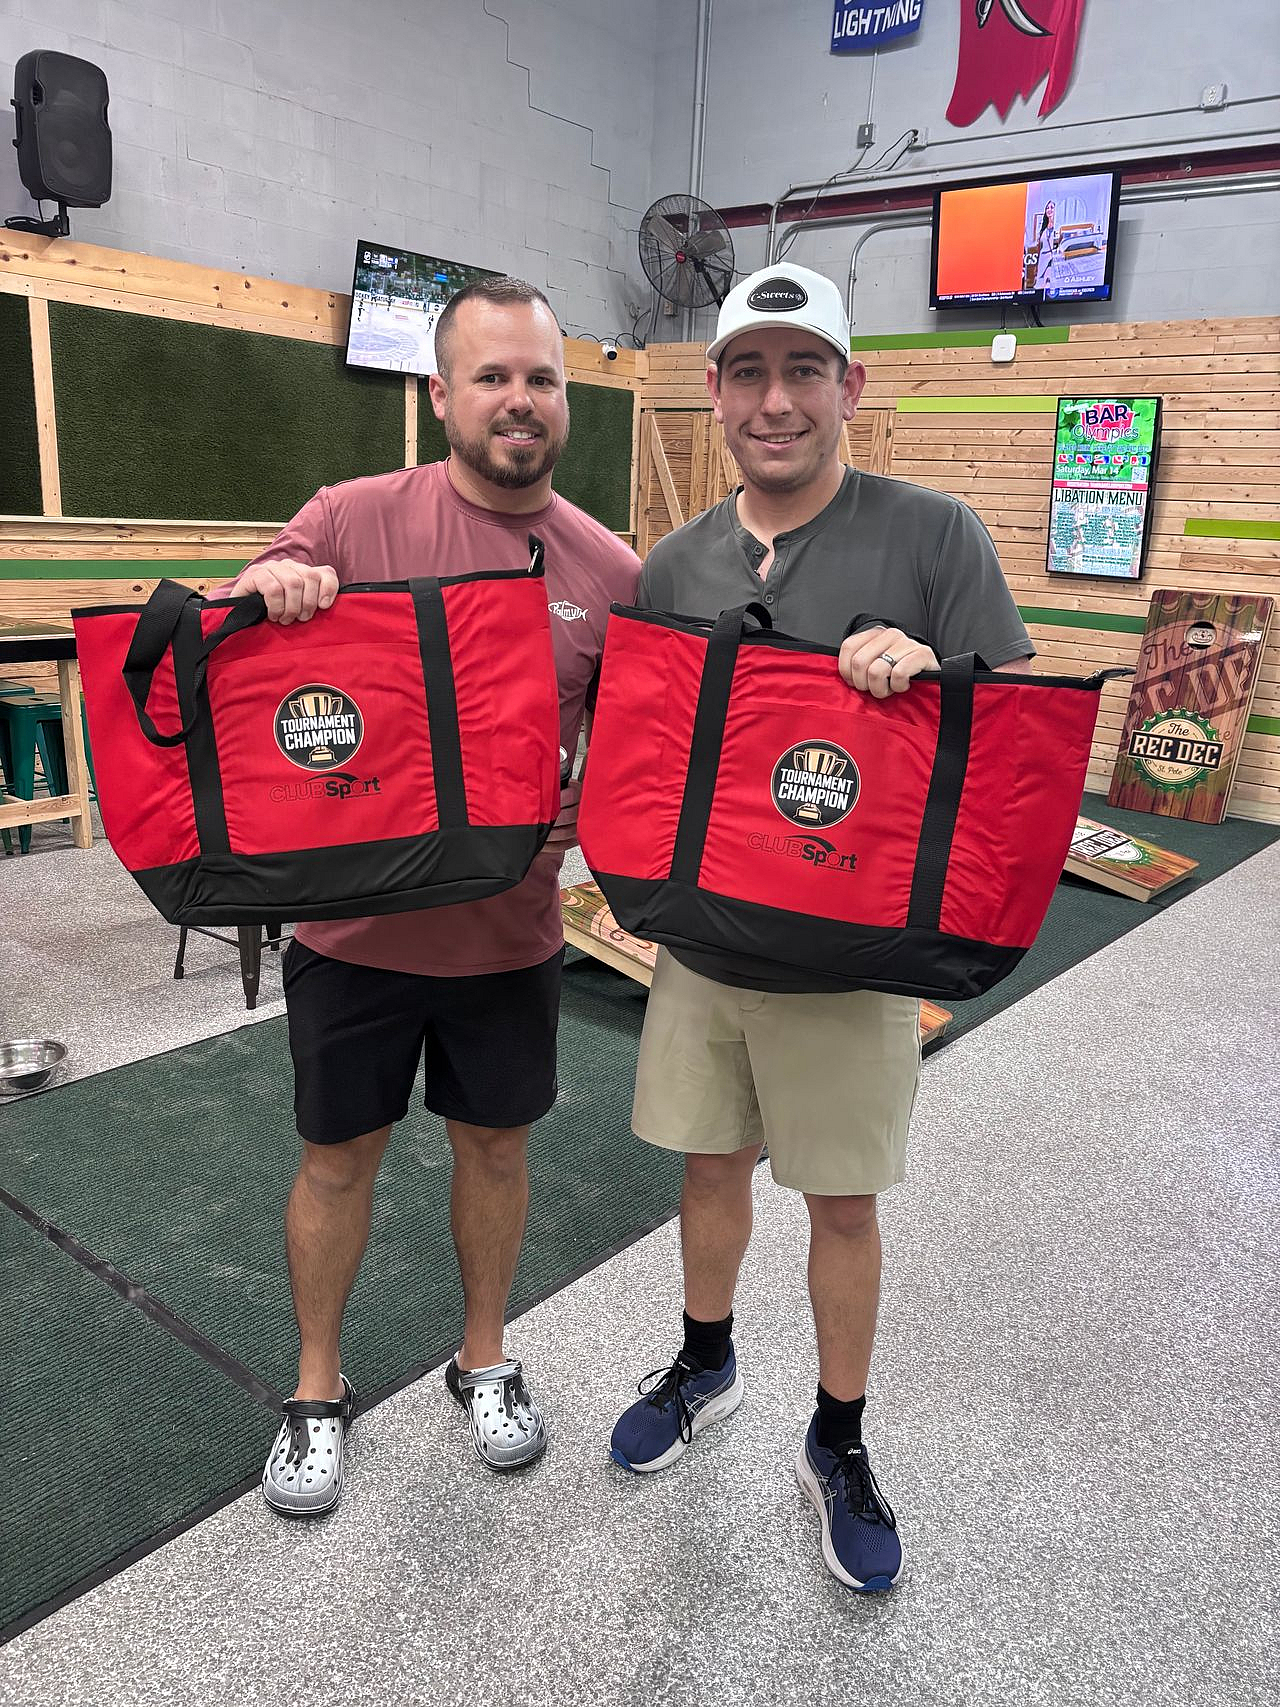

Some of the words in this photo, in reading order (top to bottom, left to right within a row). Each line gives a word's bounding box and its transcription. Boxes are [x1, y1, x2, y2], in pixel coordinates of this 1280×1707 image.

[1086, 404, 1128, 425] BAR
[1073, 424, 1139, 444] Olympics
[1056, 464, 1091, 475] Saturday,
[1091, 466, 1107, 474] Mar
[1109, 467, 1119, 475] 14
[1055, 489, 1105, 504] LIBATION
[1107, 491, 1143, 505] MENU
[281, 714, 356, 734] TOURNAMENT
[1168, 723, 1190, 736] The
[284, 728, 356, 750] CHAMPION
[1132, 735, 1174, 761] REC
[1175, 741, 1219, 766] DEC
[780, 768, 854, 794] TOURNAMENT
[777, 782, 849, 811] CHAMPION
